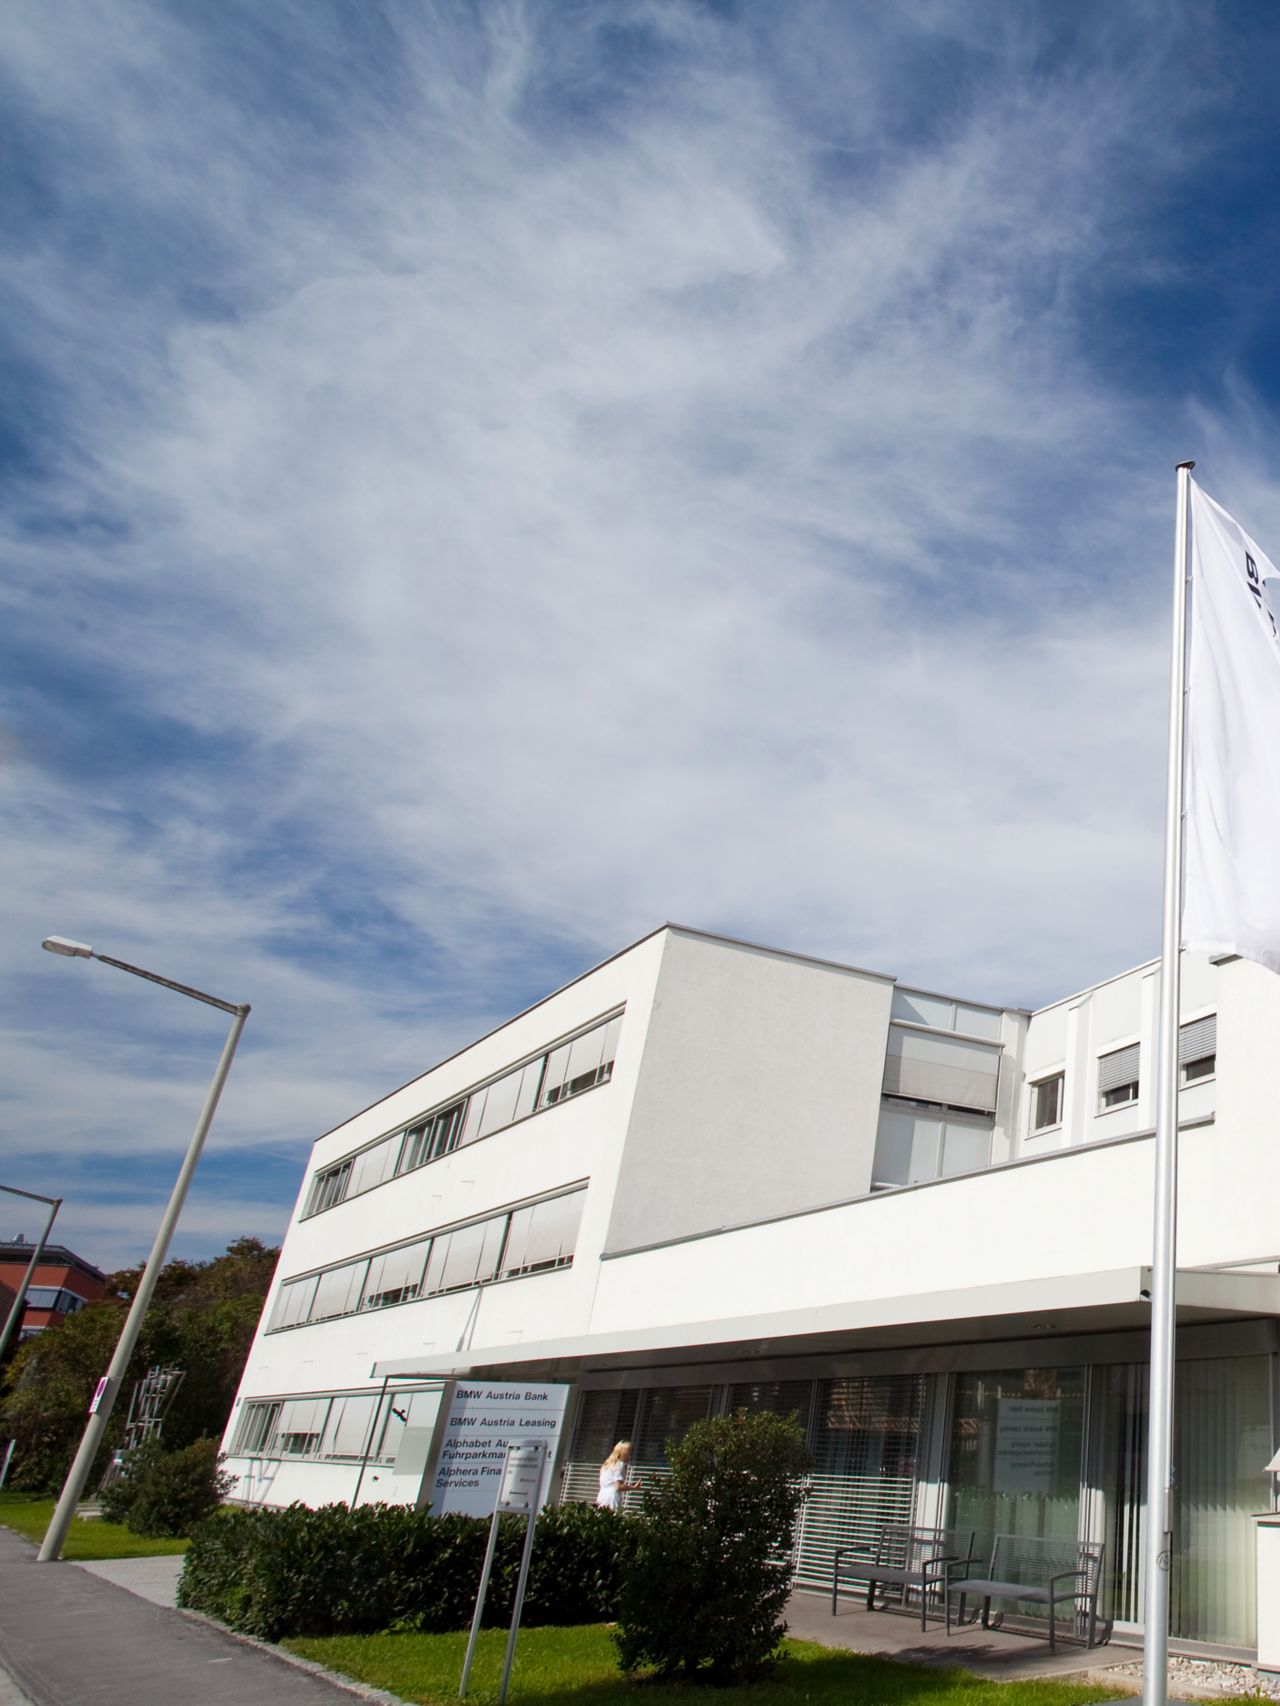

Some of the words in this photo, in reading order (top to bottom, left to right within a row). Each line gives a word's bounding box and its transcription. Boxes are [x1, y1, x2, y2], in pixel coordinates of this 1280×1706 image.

[456, 1390, 483, 1399] BMW
[486, 1391, 521, 1400] Austria
[524, 1392, 549, 1401] Bank
[450, 1417, 477, 1426] BMW
[480, 1418, 516, 1427] Austria
[519, 1418, 557, 1428] Leasing
[445, 1439, 492, 1449] Alphabet
[438, 1467, 479, 1477] Alphera
[435, 1478, 480, 1488] Services
